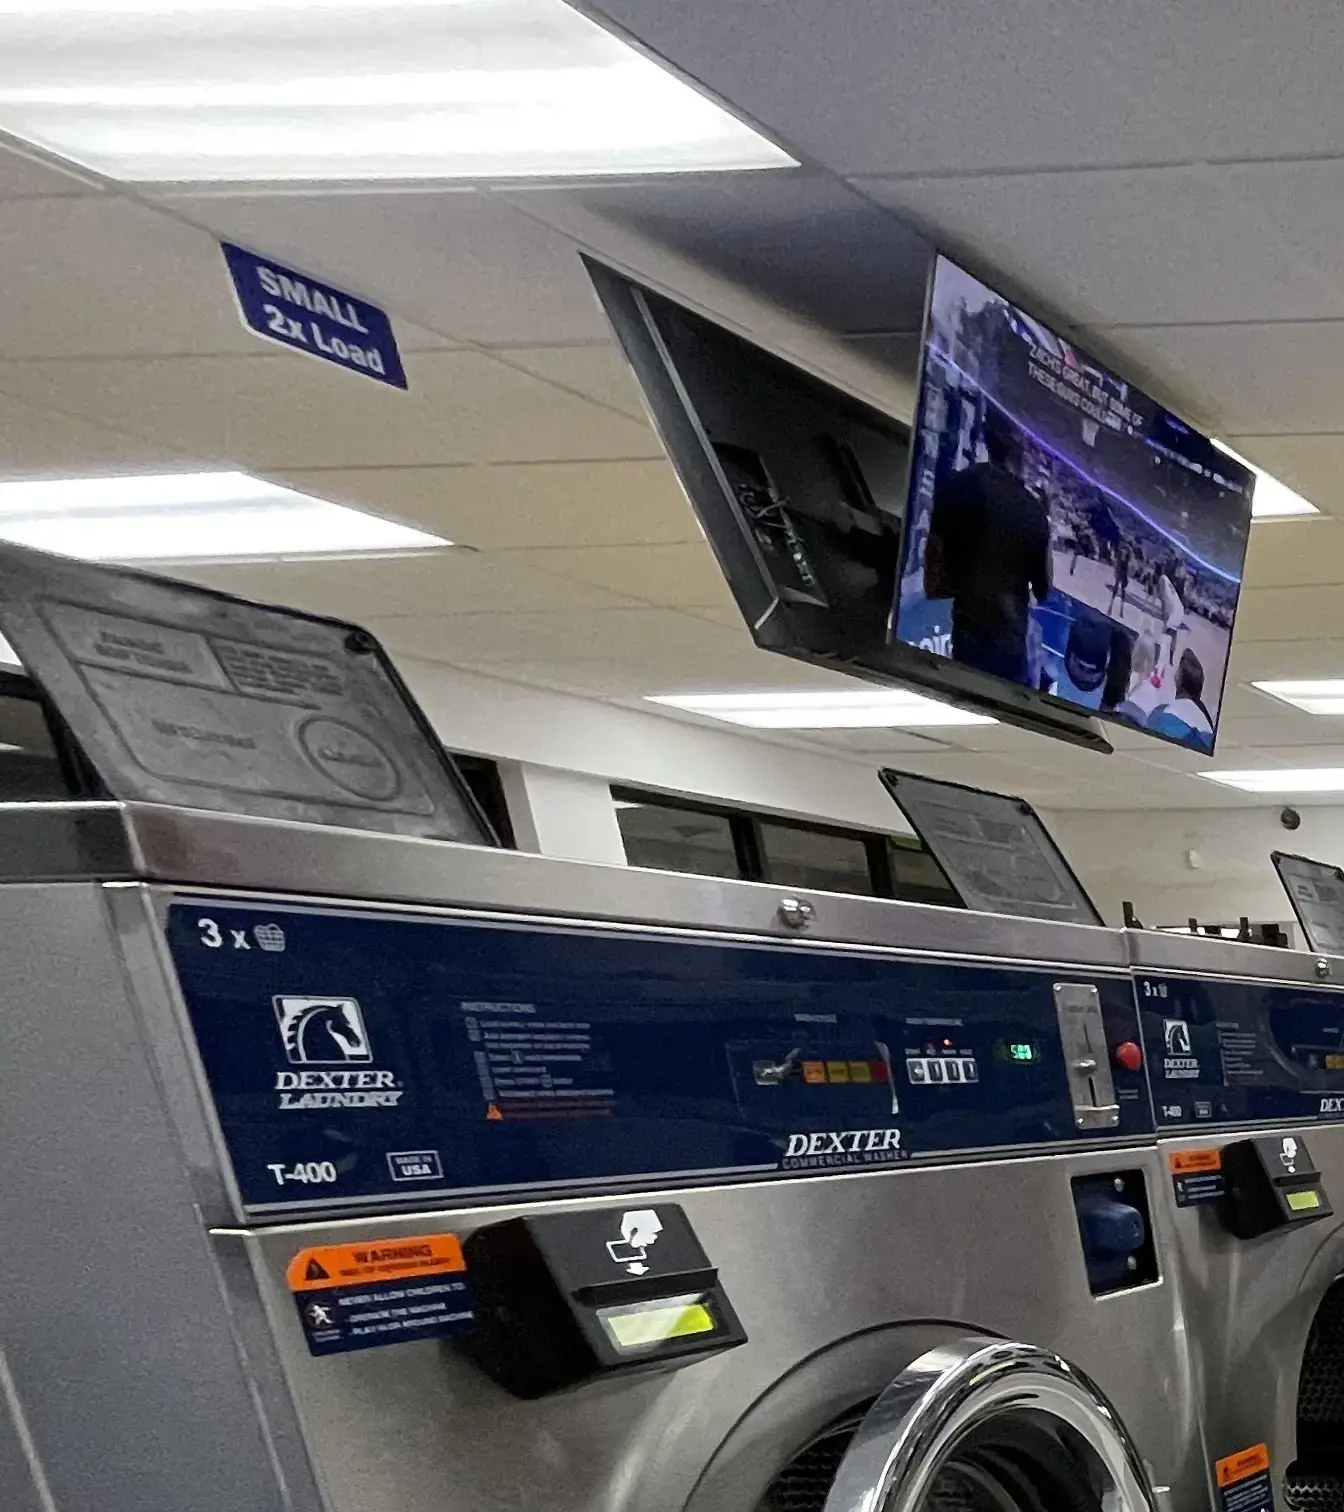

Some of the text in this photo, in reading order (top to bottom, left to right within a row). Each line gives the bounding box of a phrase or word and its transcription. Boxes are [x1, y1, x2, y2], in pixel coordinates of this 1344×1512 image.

[255, 265, 369, 335] SMALL
[262, 302, 386, 376] 2x Load
[197, 918, 252, 950] 3 x
[274, 1071, 397, 1090] DEXTER
[278, 1091, 404, 1110] LAUNDRY
[784, 1129, 901, 1157] DEXTER
[401, 1164, 433, 1176] USA
[782, 1149, 909, 1170] COMMERCIAL WASHER
[267, 1161, 337, 1186] T-400
[352, 1244, 433, 1264] WARNING
